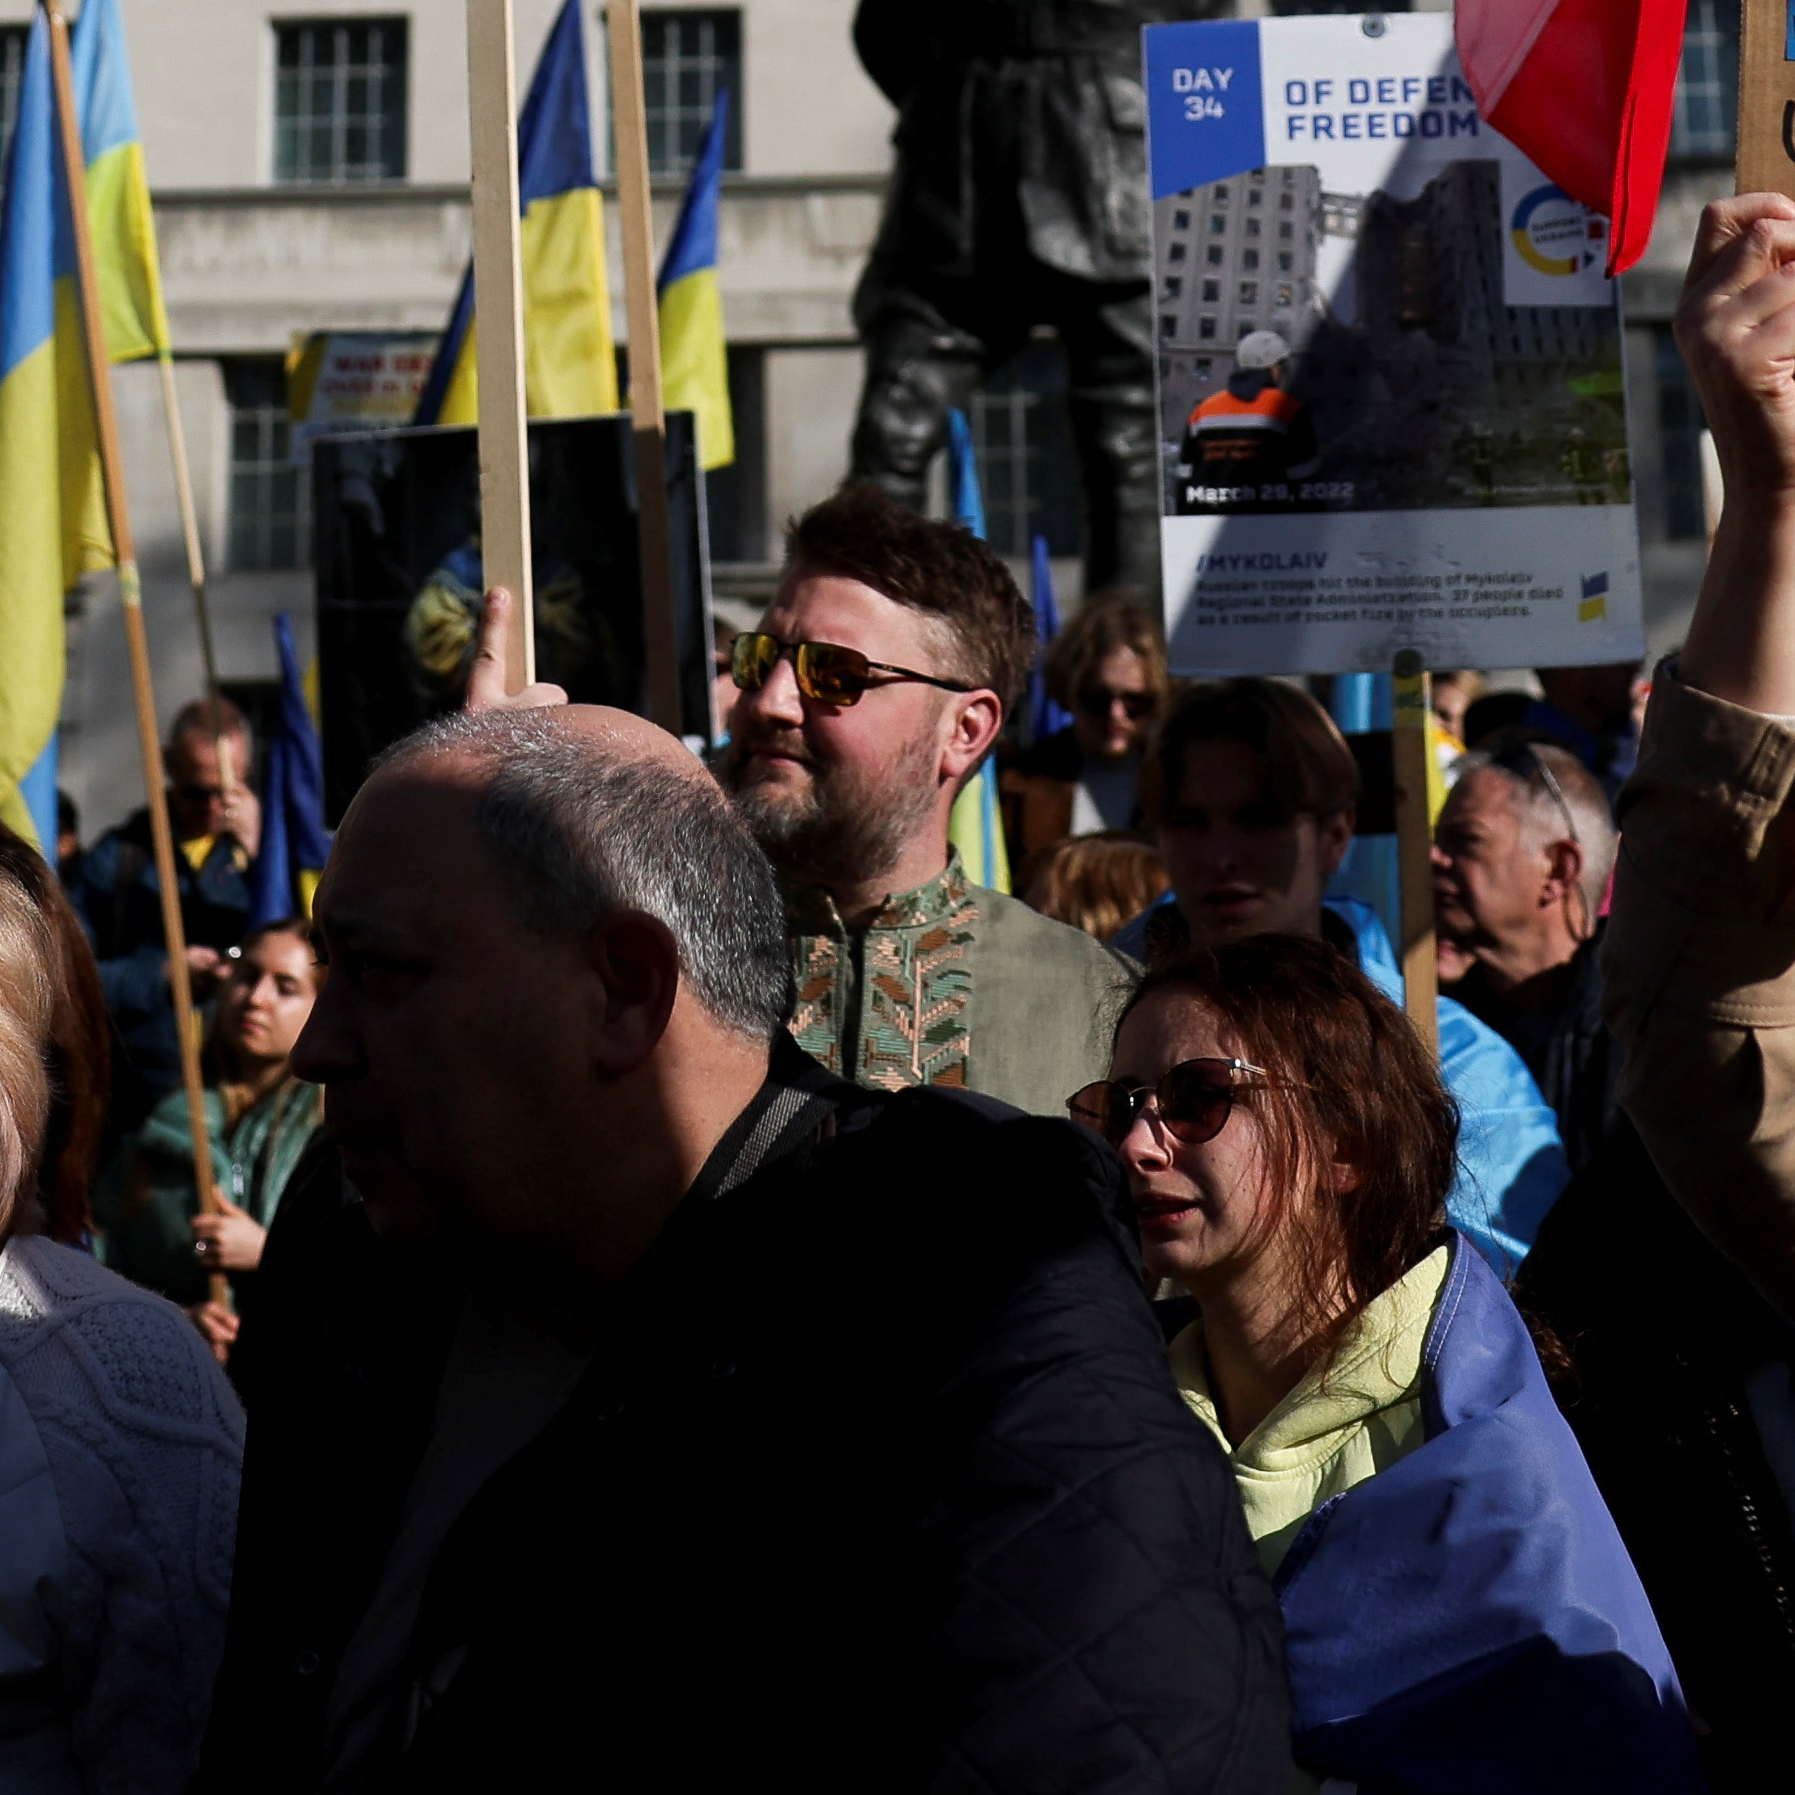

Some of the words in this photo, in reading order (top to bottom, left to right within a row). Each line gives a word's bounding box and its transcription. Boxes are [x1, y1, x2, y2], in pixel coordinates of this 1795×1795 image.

[1172, 68, 1234, 94] DAY
[1285, 79, 1334, 106] OF
[1349, 76, 1475, 105] DEFEN
[1184, 97, 1225, 121] 34
[1287, 111, 1480, 141] FREEDOM
[1185, 484, 1257, 504] March
[1300, 480, 1356, 500] 2022
[1346, 574, 1373, 588] the
[1446, 572, 1462, 586] of
[1465, 571, 1534, 587] Mykolaiv
[1269, 593, 1312, 608] State
[1472, 587, 1525, 603] people
[1527, 586, 1564, 600] died
